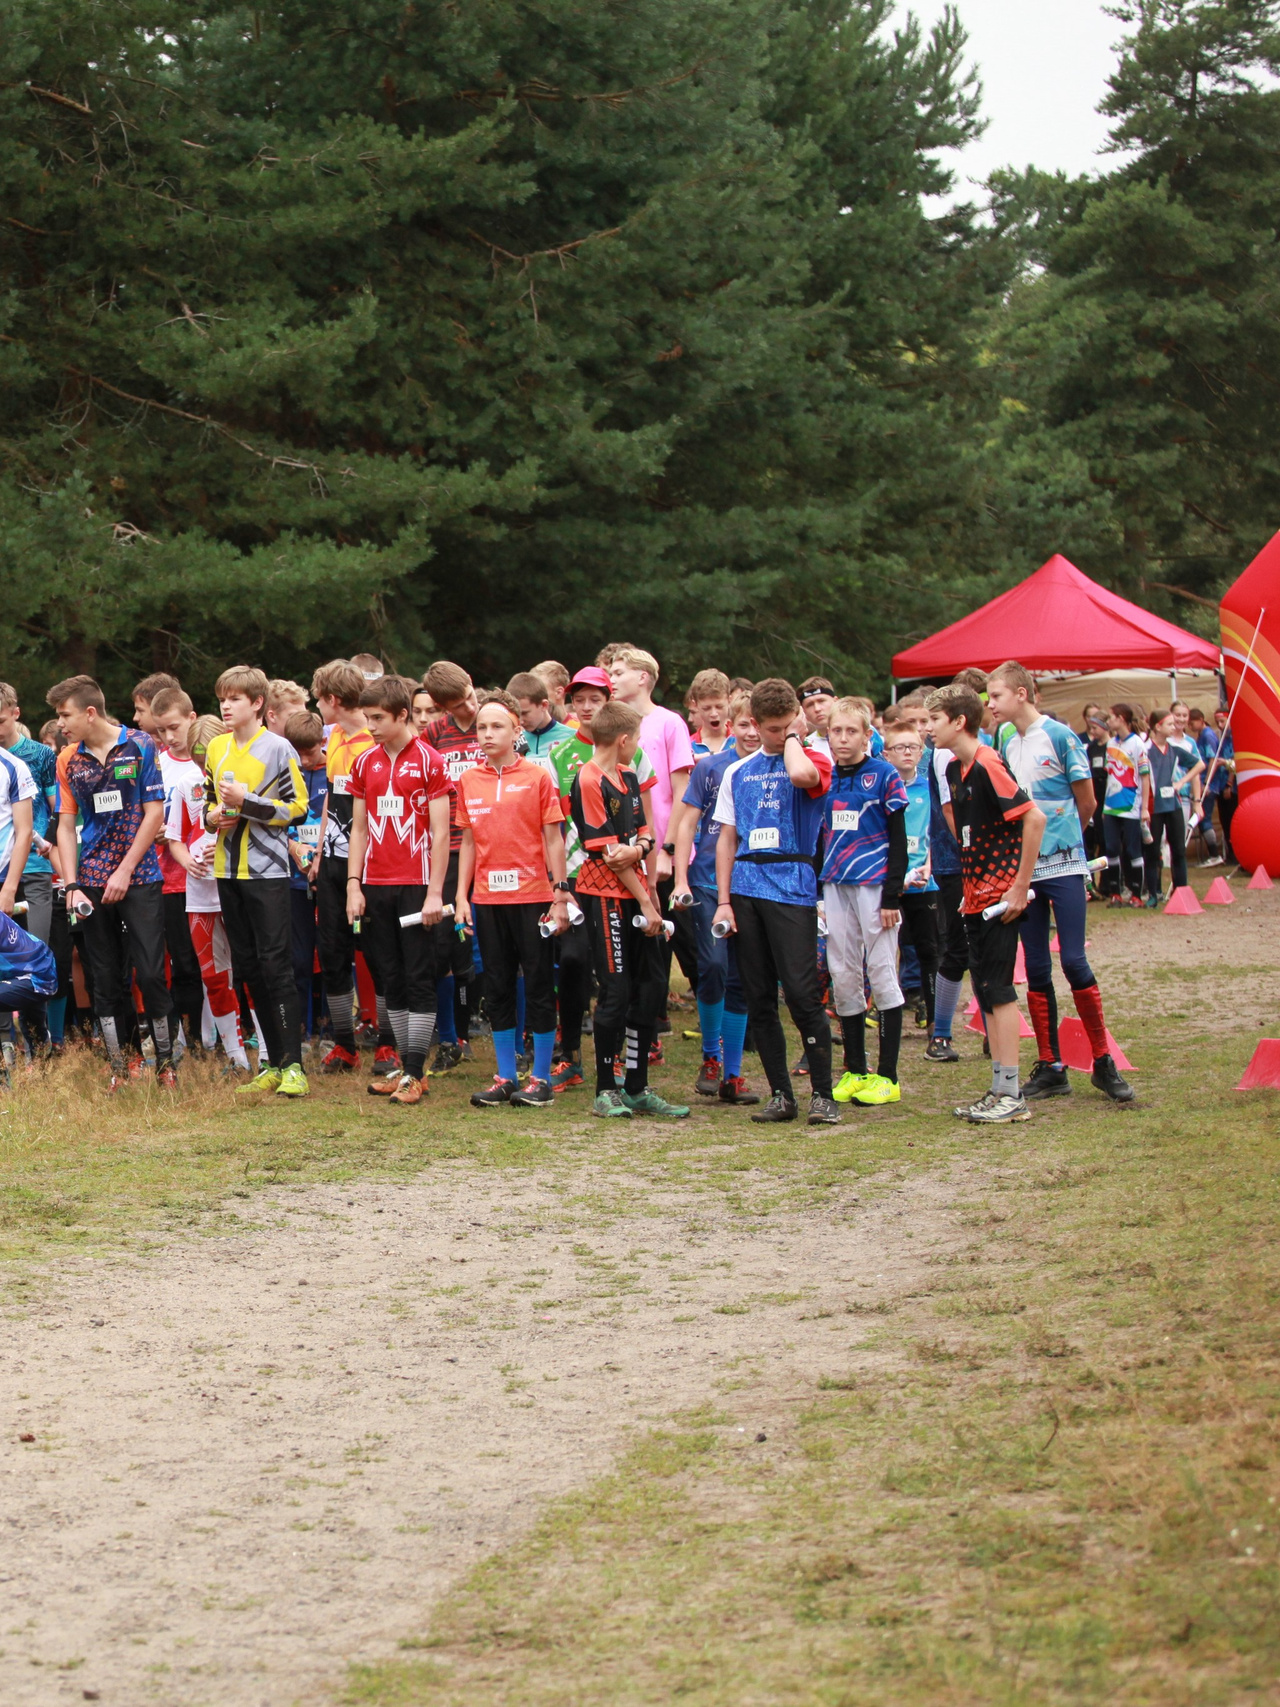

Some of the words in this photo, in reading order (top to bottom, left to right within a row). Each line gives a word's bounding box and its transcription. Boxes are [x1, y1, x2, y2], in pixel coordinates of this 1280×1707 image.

[440, 751, 460, 762] ORD
[761, 780, 779, 790] Way
[98, 794, 119, 805] 1009
[764, 791, 774, 799] of
[379, 800, 399, 808] 1011
[835, 813, 856, 823] 1029
[300, 828, 318, 836] 1041
[753, 831, 775, 842] 1014
[493, 874, 514, 884] 1012
